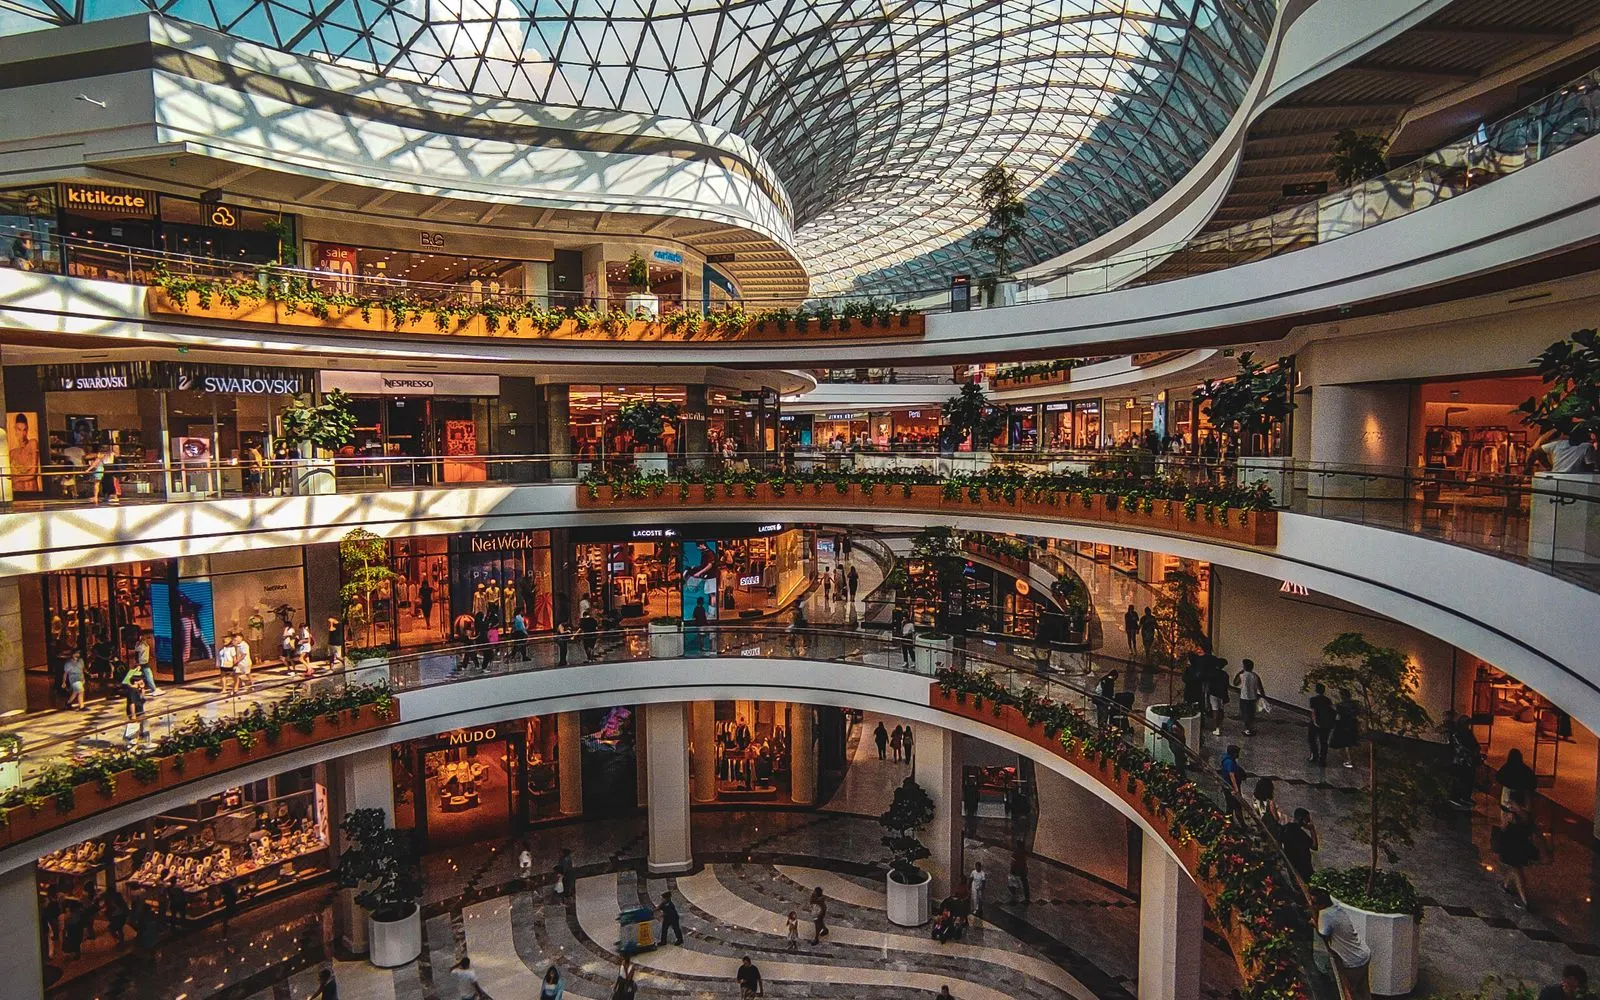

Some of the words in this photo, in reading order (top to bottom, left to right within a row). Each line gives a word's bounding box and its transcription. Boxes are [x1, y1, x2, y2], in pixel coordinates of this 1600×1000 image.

[68, 188, 145, 207] kitikate
[326, 248, 348, 259] sale
[76, 376, 128, 389] SWAROVSKI
[204, 377, 299, 394] SWAROVSKI
[383, 378, 434, 388] NESPRESSO
[633, 529, 663, 537] LACOSTE
[449, 728, 497, 746] MUDO
